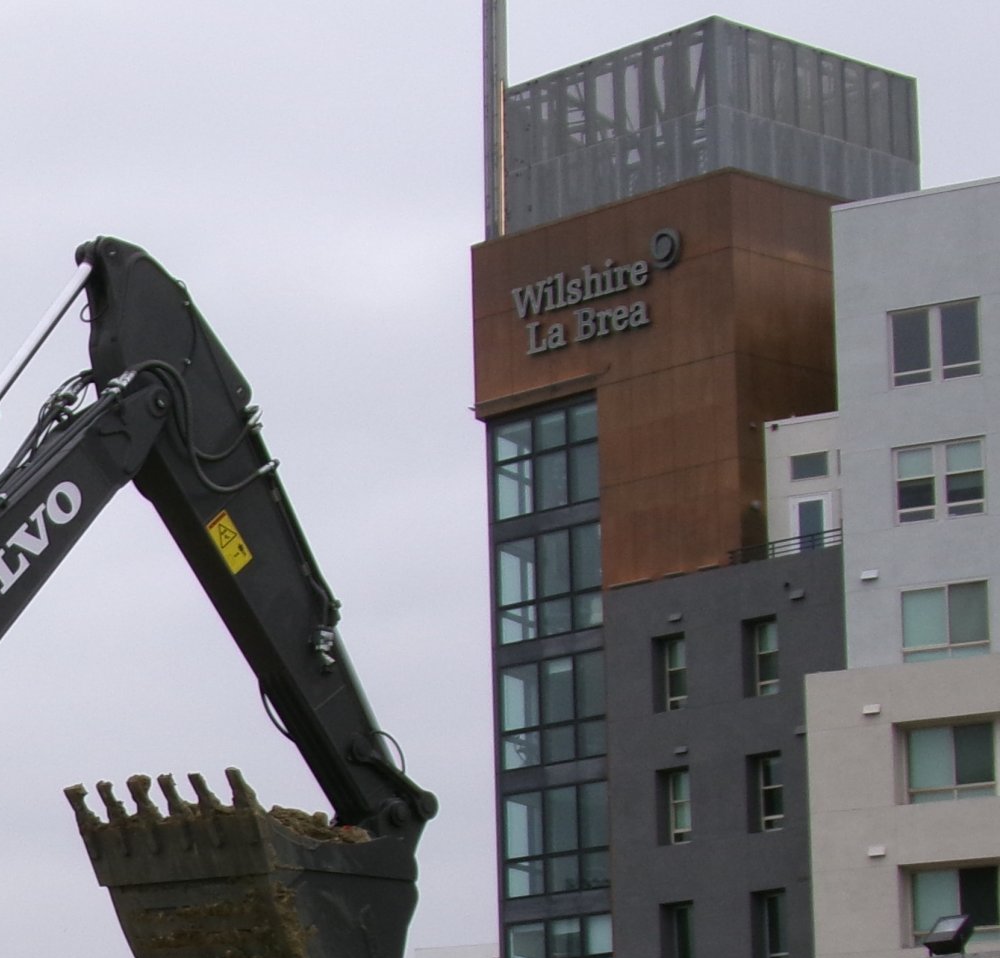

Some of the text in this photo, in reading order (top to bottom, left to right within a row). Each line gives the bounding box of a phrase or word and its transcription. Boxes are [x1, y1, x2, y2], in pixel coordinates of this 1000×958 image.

[511, 258, 649, 319] Wilshire
[526, 301, 650, 355] La Brea
